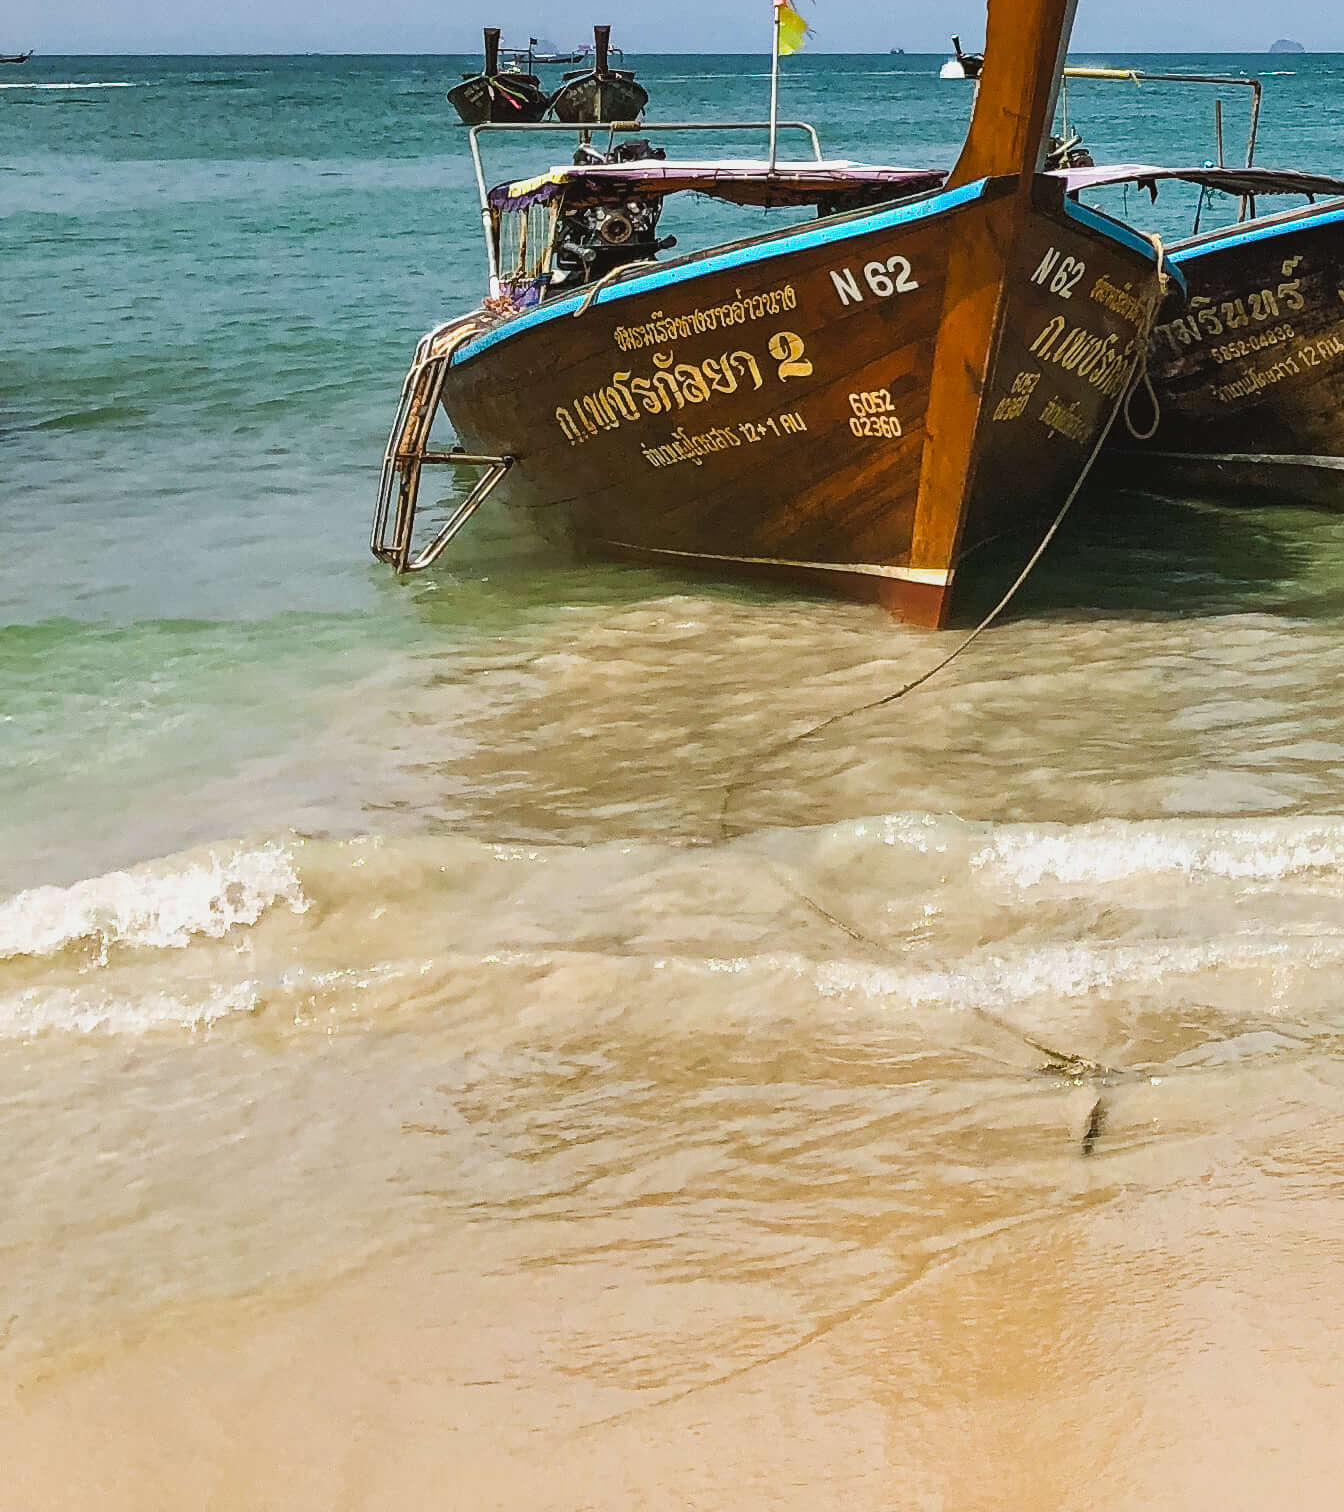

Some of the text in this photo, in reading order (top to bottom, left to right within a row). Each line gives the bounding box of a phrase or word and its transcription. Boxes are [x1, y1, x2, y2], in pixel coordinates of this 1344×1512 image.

[830, 255, 919, 305] N 62
[1050, 256, 1086, 299] 62
[849, 388, 895, 417] 6052
[849, 415, 902, 438] 02360
